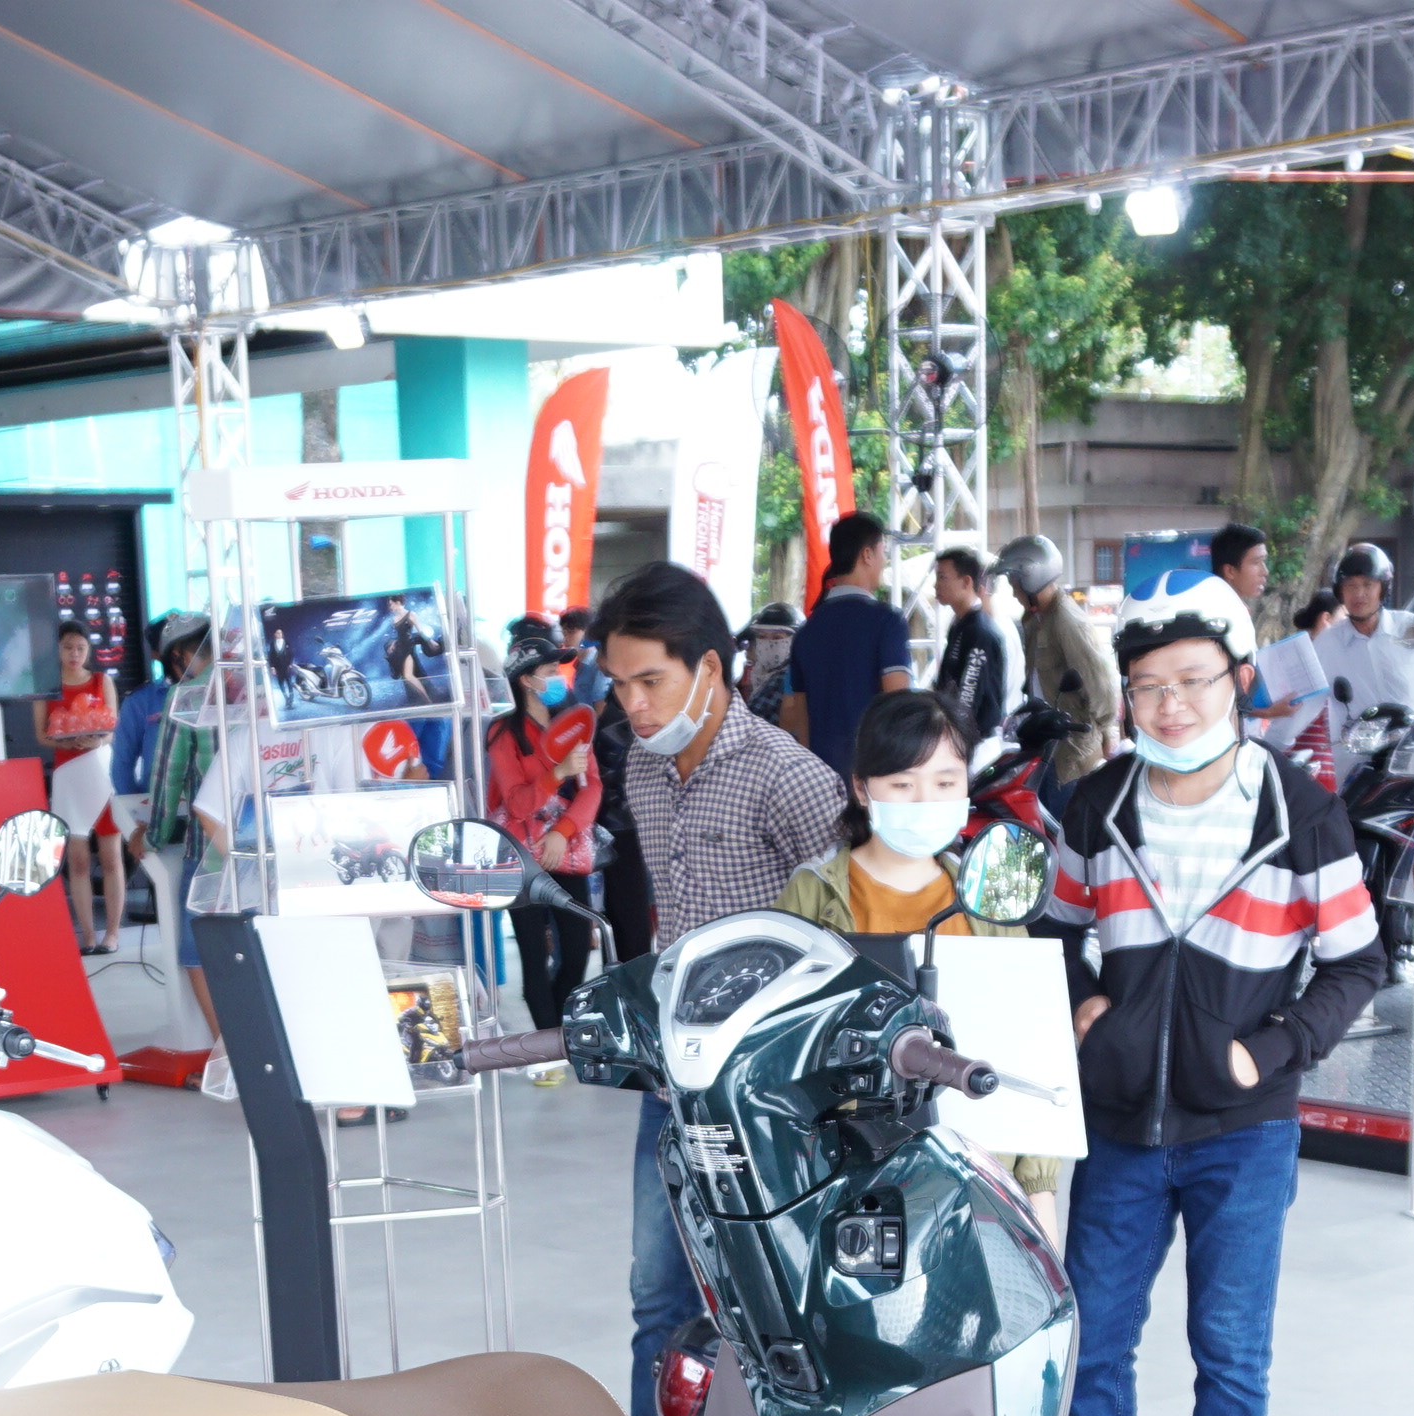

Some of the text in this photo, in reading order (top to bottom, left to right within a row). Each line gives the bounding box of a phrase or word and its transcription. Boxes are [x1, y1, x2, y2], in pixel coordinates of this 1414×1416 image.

[313, 485, 406, 500] HONDA
[708, 501, 726, 566] Honda
[259, 739, 303, 761] astrol
